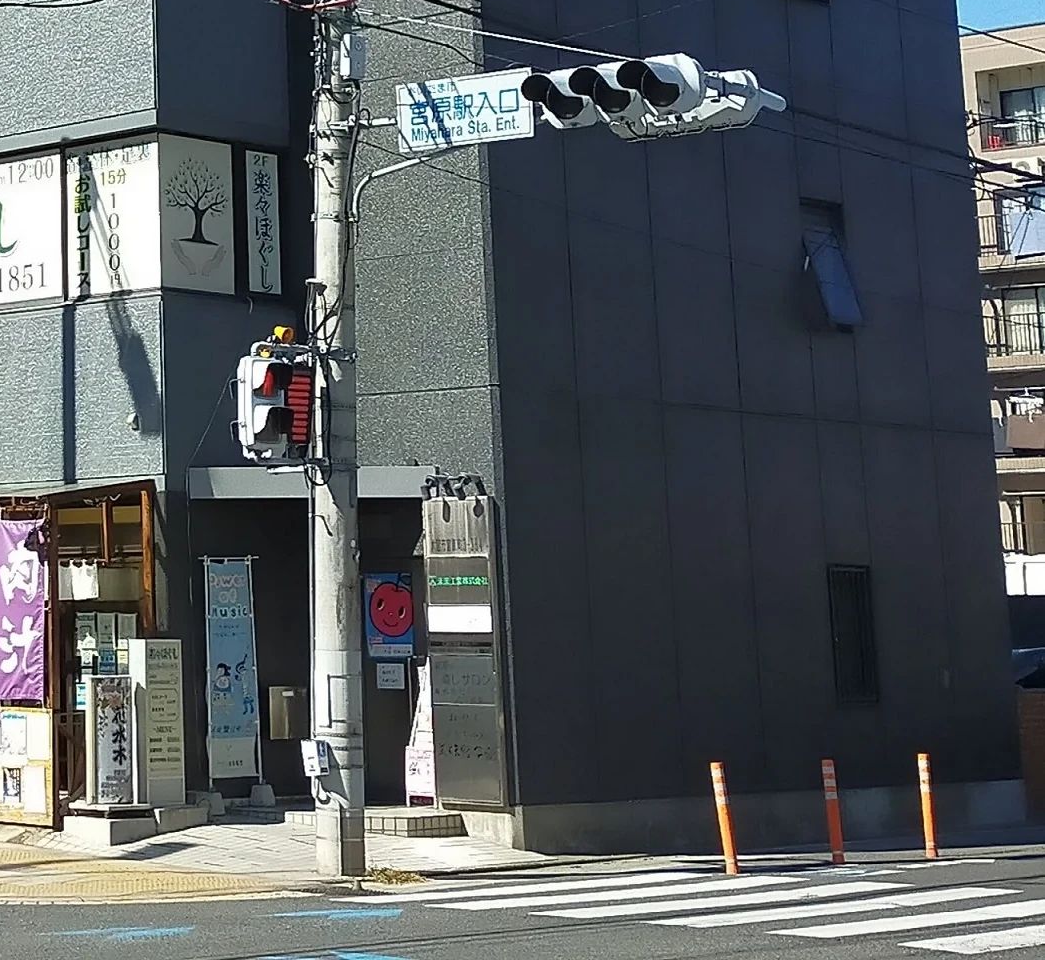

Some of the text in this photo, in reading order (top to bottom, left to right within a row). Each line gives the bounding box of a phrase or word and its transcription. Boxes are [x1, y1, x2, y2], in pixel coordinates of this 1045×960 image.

[410, 88, 519, 126] 宮原駅入口
[411, 116, 520, 143] Miyahara Sta. Ent.
[100, 168, 126, 186] 15分
[253, 155, 268, 166] 2F
[74, 174, 92, 288] お試しコース
[253, 171, 274, 293] 楽々ほぐし
[0, 540, 40, 675] 肉汁
